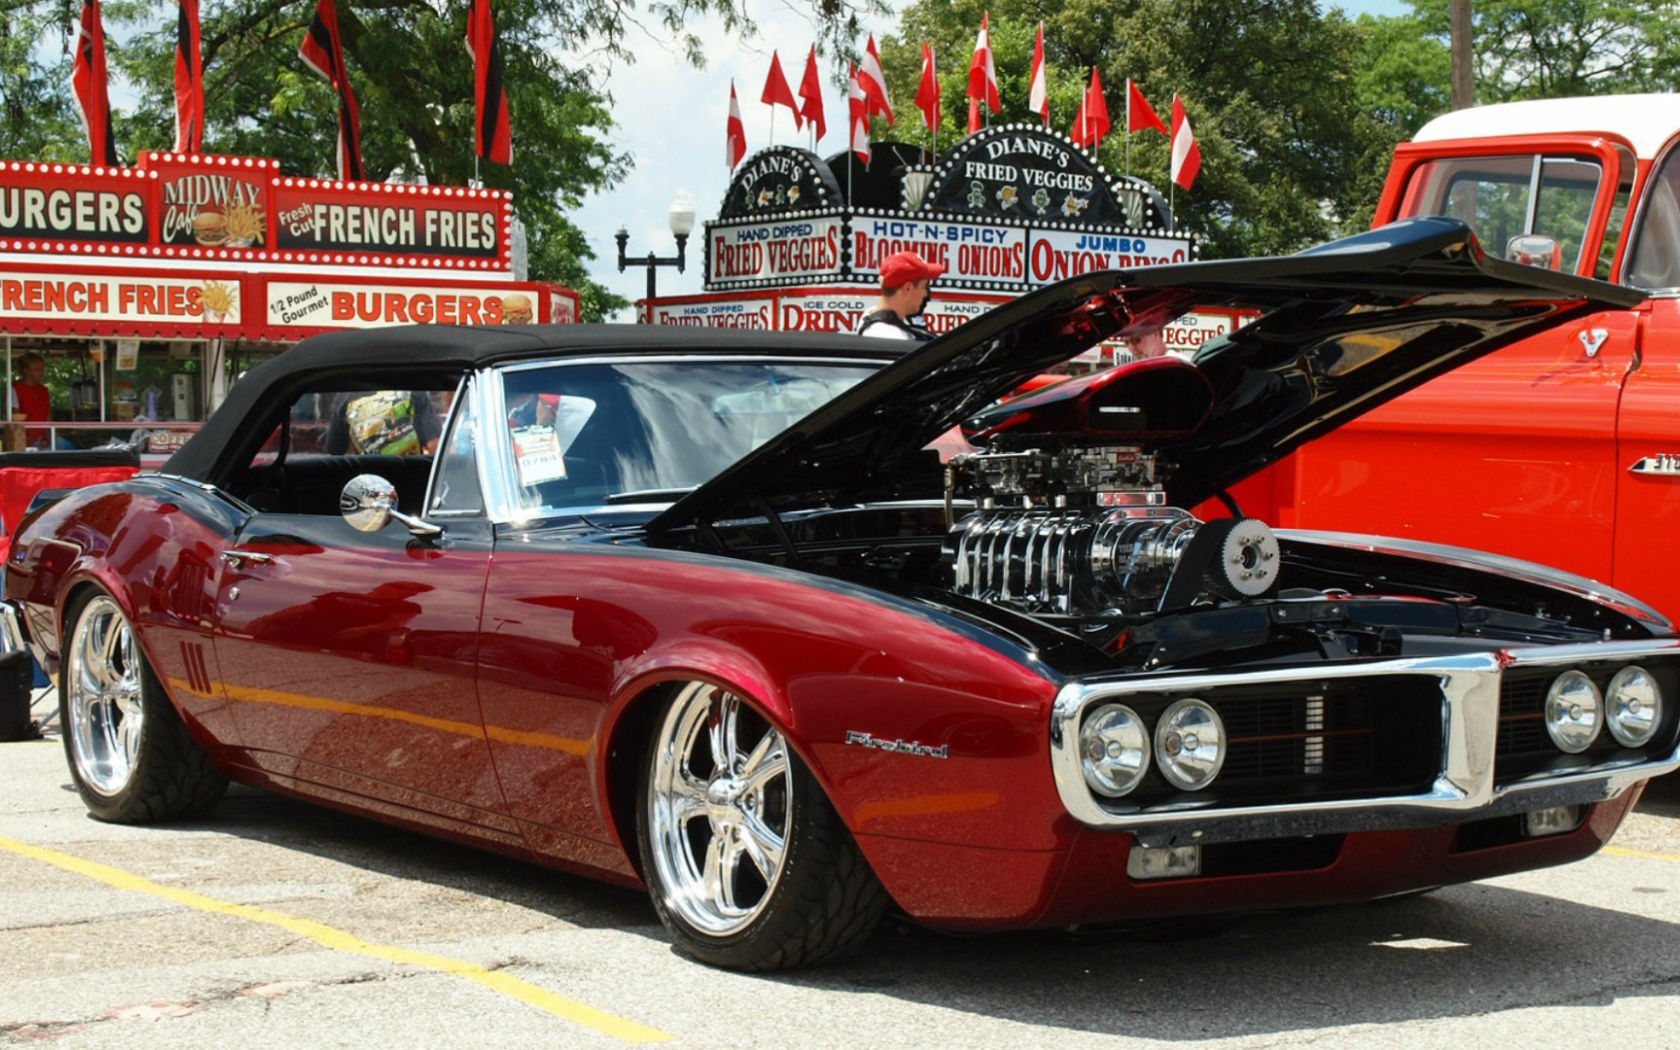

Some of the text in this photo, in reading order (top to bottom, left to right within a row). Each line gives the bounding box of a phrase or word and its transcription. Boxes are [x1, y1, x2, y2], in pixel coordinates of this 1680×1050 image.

[986, 137, 1069, 168] DIANE'S
[741, 156, 801, 191] DIANE'S
[965, 161, 1093, 191] FRIED VEGGIES
[164, 174, 260, 207] MIDWAY
[0, 187, 144, 234] URGERS
[278, 202, 313, 226] Fresh
[290, 217, 316, 237] Cut
[314, 204, 495, 249] FRENCH FRIES
[737, 224, 812, 242] HAND DIPPED
[874, 222, 1008, 244] HOT-N-SPICY
[715, 225, 837, 277] FRIED VEGGIES
[1076, 235, 1146, 253] JUMBO
[958, 242, 1023, 278] ONIONS
[1031, 238, 1110, 281] ONION
[0, 279, 204, 316] RENCH FRIES
[270, 285, 318, 314] 1/2 Pound
[281, 296, 329, 324] Gourmet
[332, 291, 504, 325] BURGERS
[684, 305, 744, 315] HAND DIPPED
[803, 301, 823, 309] ICE
[944, 305, 980, 314] HAND
[706, 306, 769, 330] VEGGIES
[924, 313, 970, 334] RIED
[1165, 325, 1225, 346] EGGIE
[845, 730, 948, 759] Firebird
